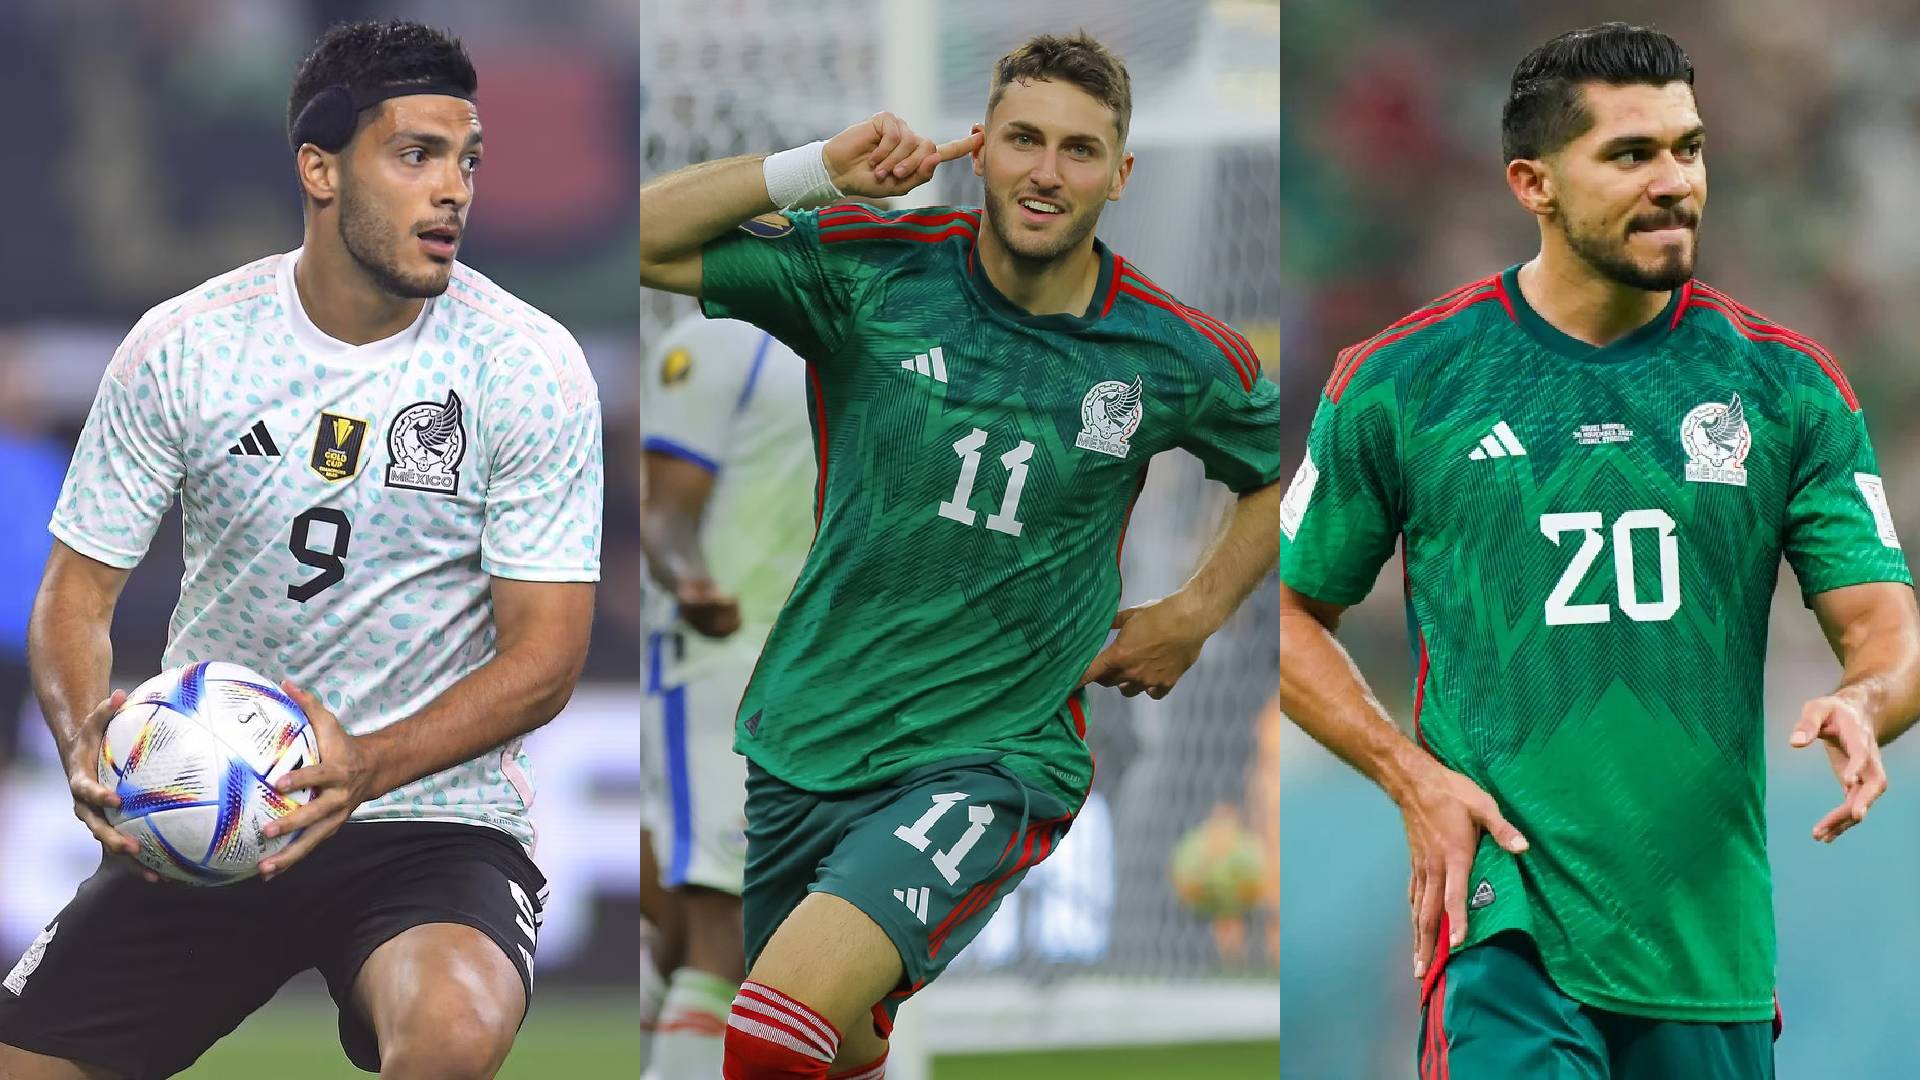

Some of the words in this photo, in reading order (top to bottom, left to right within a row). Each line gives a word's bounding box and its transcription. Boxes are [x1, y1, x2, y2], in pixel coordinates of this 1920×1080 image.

[325, 459, 343, 468] CUP
[938, 428, 1035, 537] 11
[287, 507, 352, 603] 9
[1540, 508, 1681, 625] 20
[893, 791, 995, 886] 11
